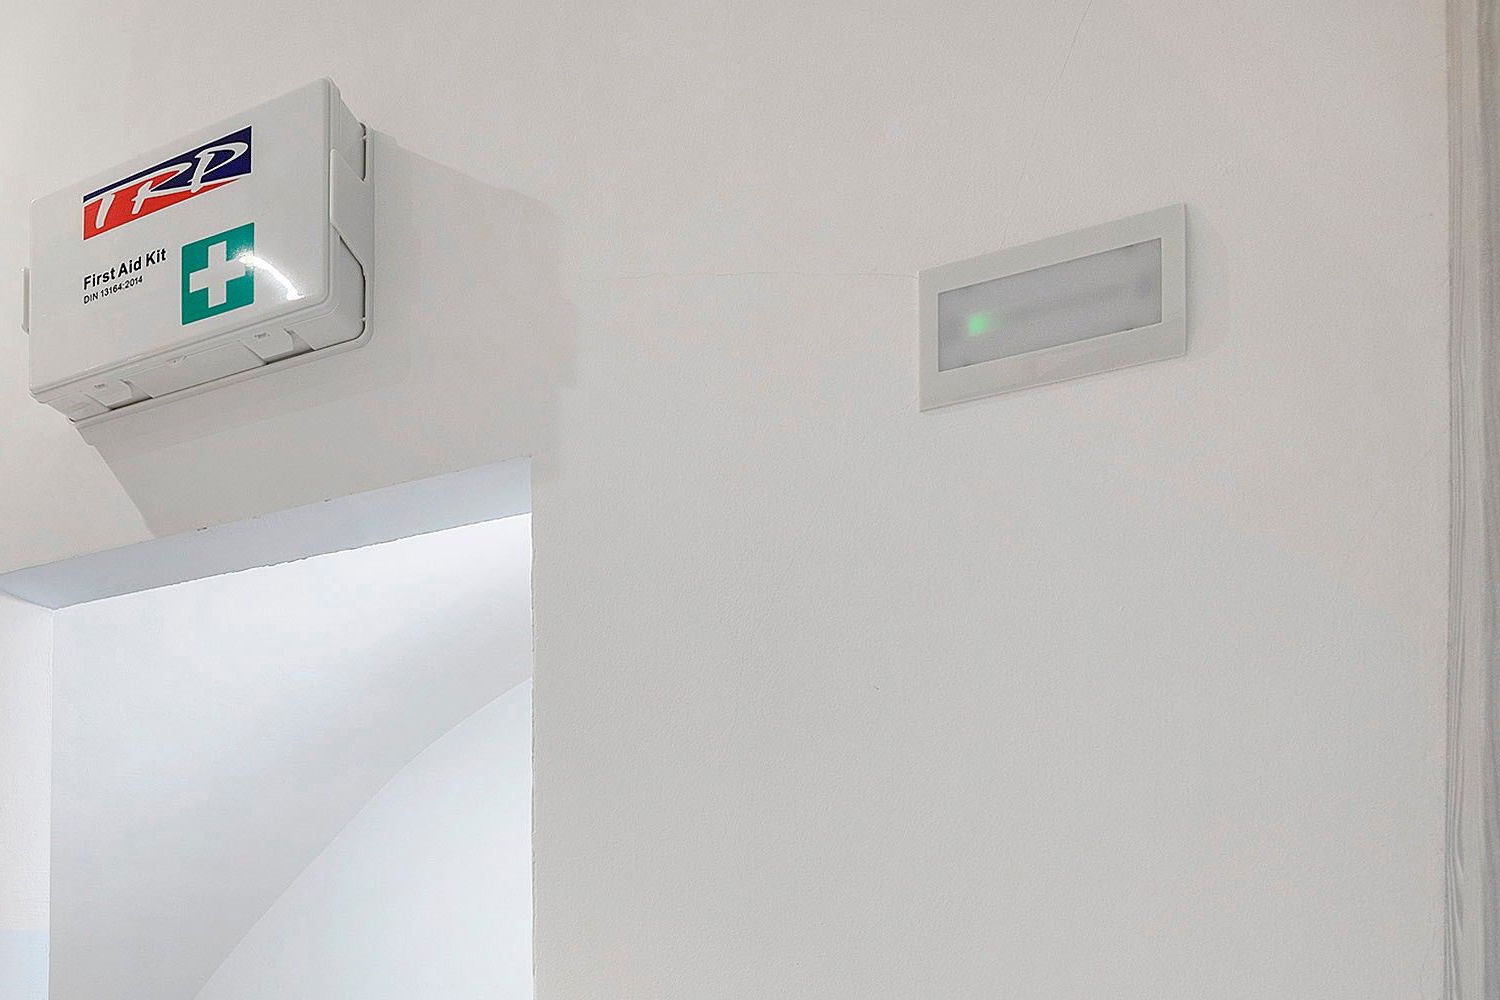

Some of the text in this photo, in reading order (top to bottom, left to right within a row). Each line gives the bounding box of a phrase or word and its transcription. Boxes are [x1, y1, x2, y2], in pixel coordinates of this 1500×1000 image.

[83, 247, 166, 290] First Aid Kit
[83, 275, 143, 304] DIN 13164:2014
